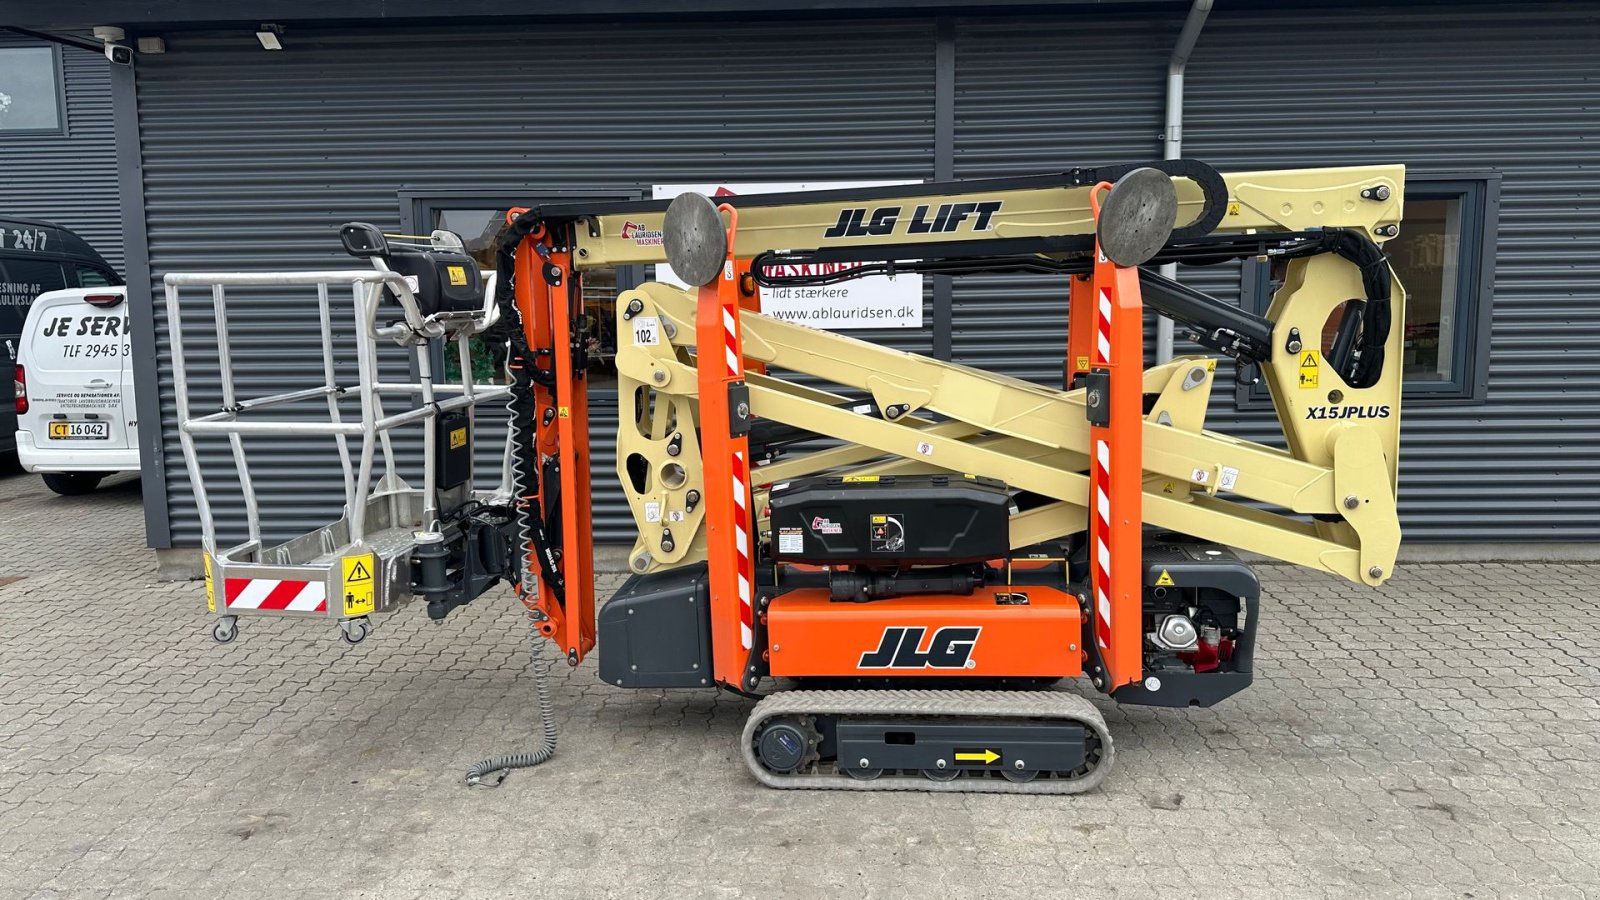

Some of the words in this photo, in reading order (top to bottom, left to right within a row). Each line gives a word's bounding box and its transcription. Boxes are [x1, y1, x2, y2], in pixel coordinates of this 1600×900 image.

[823, 206, 903, 238] JLG
[906, 200, 1004, 235] LIFT
[12, 228, 47, 252] 24/7
[30, 283, 41, 294] AF
[772, 287, 792, 299] lidt
[794, 287, 849, 299] stærkere
[773, 306, 915, 320] www.ablauridsen.dk
[43, 317, 73, 337] JE
[635, 329, 652, 343] 102
[63, 344, 82, 358] TLF
[85, 343, 118, 359] 2945
[122, 343, 131, 357] 3
[1306, 405, 1390, 419] X15JPLUS
[54, 424, 68, 435] CT
[70, 424, 82, 435] 16
[84, 424, 103, 435] 042
[857, 626, 982, 670] JLG
